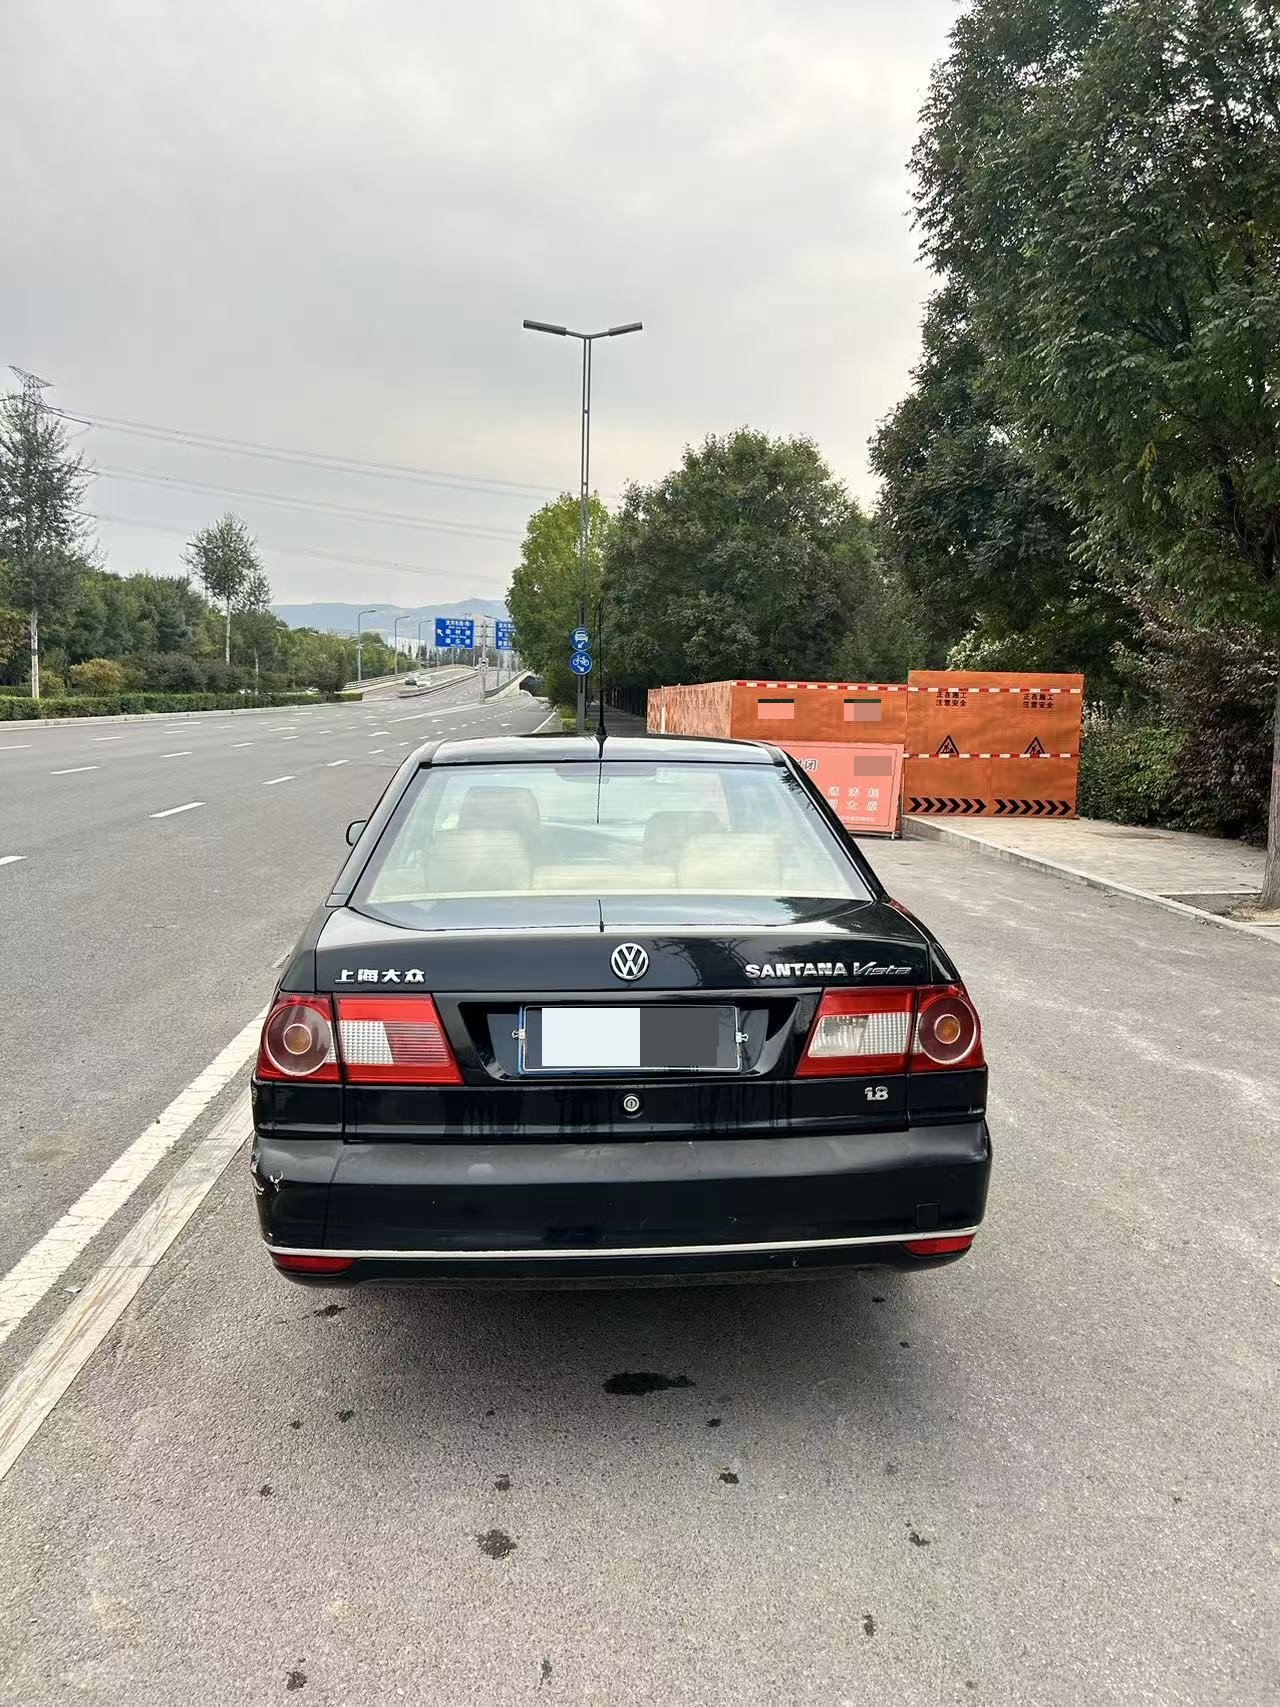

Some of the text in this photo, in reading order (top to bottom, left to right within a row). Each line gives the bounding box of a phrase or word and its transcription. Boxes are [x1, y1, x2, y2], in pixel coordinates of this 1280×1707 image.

[936, 691, 967, 699] 正在施工
[936, 699, 967, 707] 注意安全
[745, 961, 912, 978] SANTANA Vista
[335, 968, 425, 983] 上海大众
